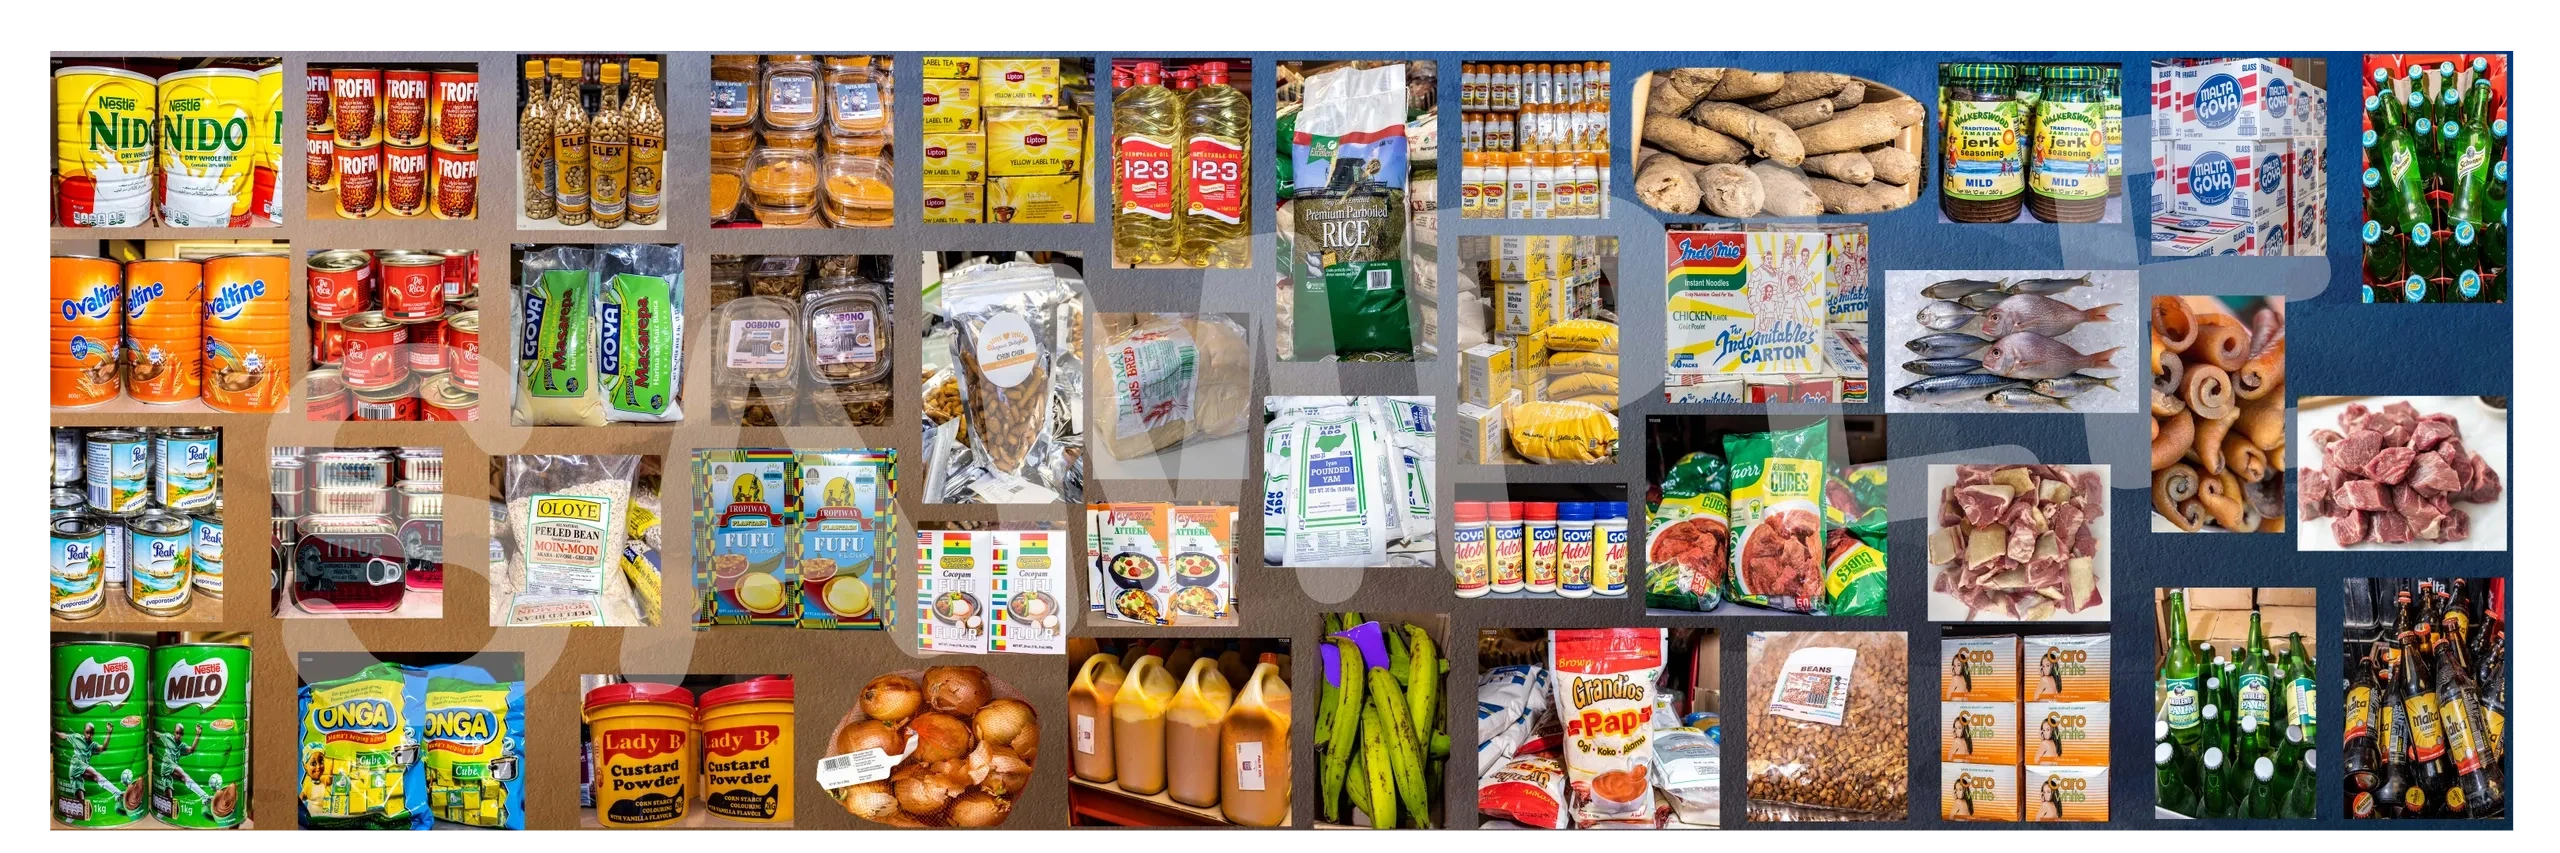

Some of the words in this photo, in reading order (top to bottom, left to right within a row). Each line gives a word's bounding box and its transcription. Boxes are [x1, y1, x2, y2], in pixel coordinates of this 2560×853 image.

[2183, 70, 2197, 78] FRAGILE
[2261, 64, 2273, 74] FRAGILE
[334, 79, 375, 98] TROFAI
[387, 80, 426, 99] TROFAI
[2201, 81, 2233, 100] MALTA
[2269, 85, 2286, 95] MALTA
[2199, 94, 2237, 119] GOYA
[2269, 95, 2287, 108] GOYA
[1954, 112, 2009, 128] WALKERSWOOD
[2042, 112, 2097, 129] WALKERSWOOD
[163, 114, 248, 152] NIDO
[561, 137, 590, 147] ELEX
[1962, 136, 1999, 149] jerk
[2050, 136, 2087, 149] jerk
[534, 144, 550, 170] ELEX
[1961, 150, 2004, 158] seasoning
[2048, 150, 2091, 159] seasoning
[1966, 179, 1992, 187] MILD
[2052, 178, 2079, 186] MILD
[1306, 210, 1345, 221] Premium
[1347, 206, 1387, 218] Parboiled
[1323, 221, 1370, 248] RICE
[1671, 238, 1740, 266] Indomie
[319, 279, 328, 287] De
[413, 276, 422, 286] De
[316, 286, 331, 295] Rica
[408, 285, 424, 294] Rica
[61, 282, 120, 321] Ovaltine
[1673, 311, 1712, 321] CHICKEN
[525, 298, 542, 356] GOYA
[552, 288, 574, 371] Masarepa
[1730, 325, 1742, 334] The
[603, 308, 618, 371] GOYA
[635, 297, 651, 388] Masarepa
[1713, 321, 1815, 366] Indomitables
[1011, 349, 1024, 357] CHIN
[1741, 345, 1806, 364] CARTON
[1129, 381, 1143, 414] BUNS
[188, 446, 208, 461] Peak
[1311, 467, 1350, 476] POUNDED
[1771, 471, 1808, 492] CUBES
[541, 502, 597, 518] OLOYE
[1265, 492, 1275, 516] IYAN
[1275, 491, 1283, 514] ADO
[820, 509, 859, 517] TROPIWAY
[535, 527, 571, 537] PEELED
[574, 530, 599, 540] BEAN
[725, 533, 775, 547] FUFU
[67, 544, 89, 560] Peak
[325, 537, 383, 557] TITUS
[535, 541, 598, 555] MOIN-MOIN
[814, 538, 864, 551] FUFU
[1837, 551, 1873, 583] CUBES
[943, 571, 971, 579] Cocoyam
[1019, 571, 1048, 579] Cocoyam
[1796, 598, 1809, 607] 50
[1958, 647, 1994, 663] Caro
[2048, 646, 2087, 663] Caro
[1559, 658, 1593, 668] Brown
[75, 672, 129, 700] MILO
[167, 674, 222, 701] MILO
[1573, 674, 1644, 709] Grandios
[2168, 705, 2197, 716] PALM
[2240, 701, 2269, 711] PALM
[319, 702, 389, 728] ONGA
[2412, 710, 2439, 728] Malta
[425, 712, 488, 738] ONGA
[1581, 709, 1640, 738] Pap
[606, 734, 659, 753] Lady
[1578, 739, 1591, 753] Ogi
[1597, 747, 1616, 756] Koko
[1623, 735, 1645, 755] Akamu
[359, 755, 382, 766] Cube
[708, 757, 770, 772] Custard
[455, 766, 479, 776] Cube
[611, 760, 679, 777] Custard
[613, 775, 680, 791] Powder
[710, 773, 771, 785] Powder
[94, 805, 106, 814] 1kg
[181, 805, 193, 815] 1kg
